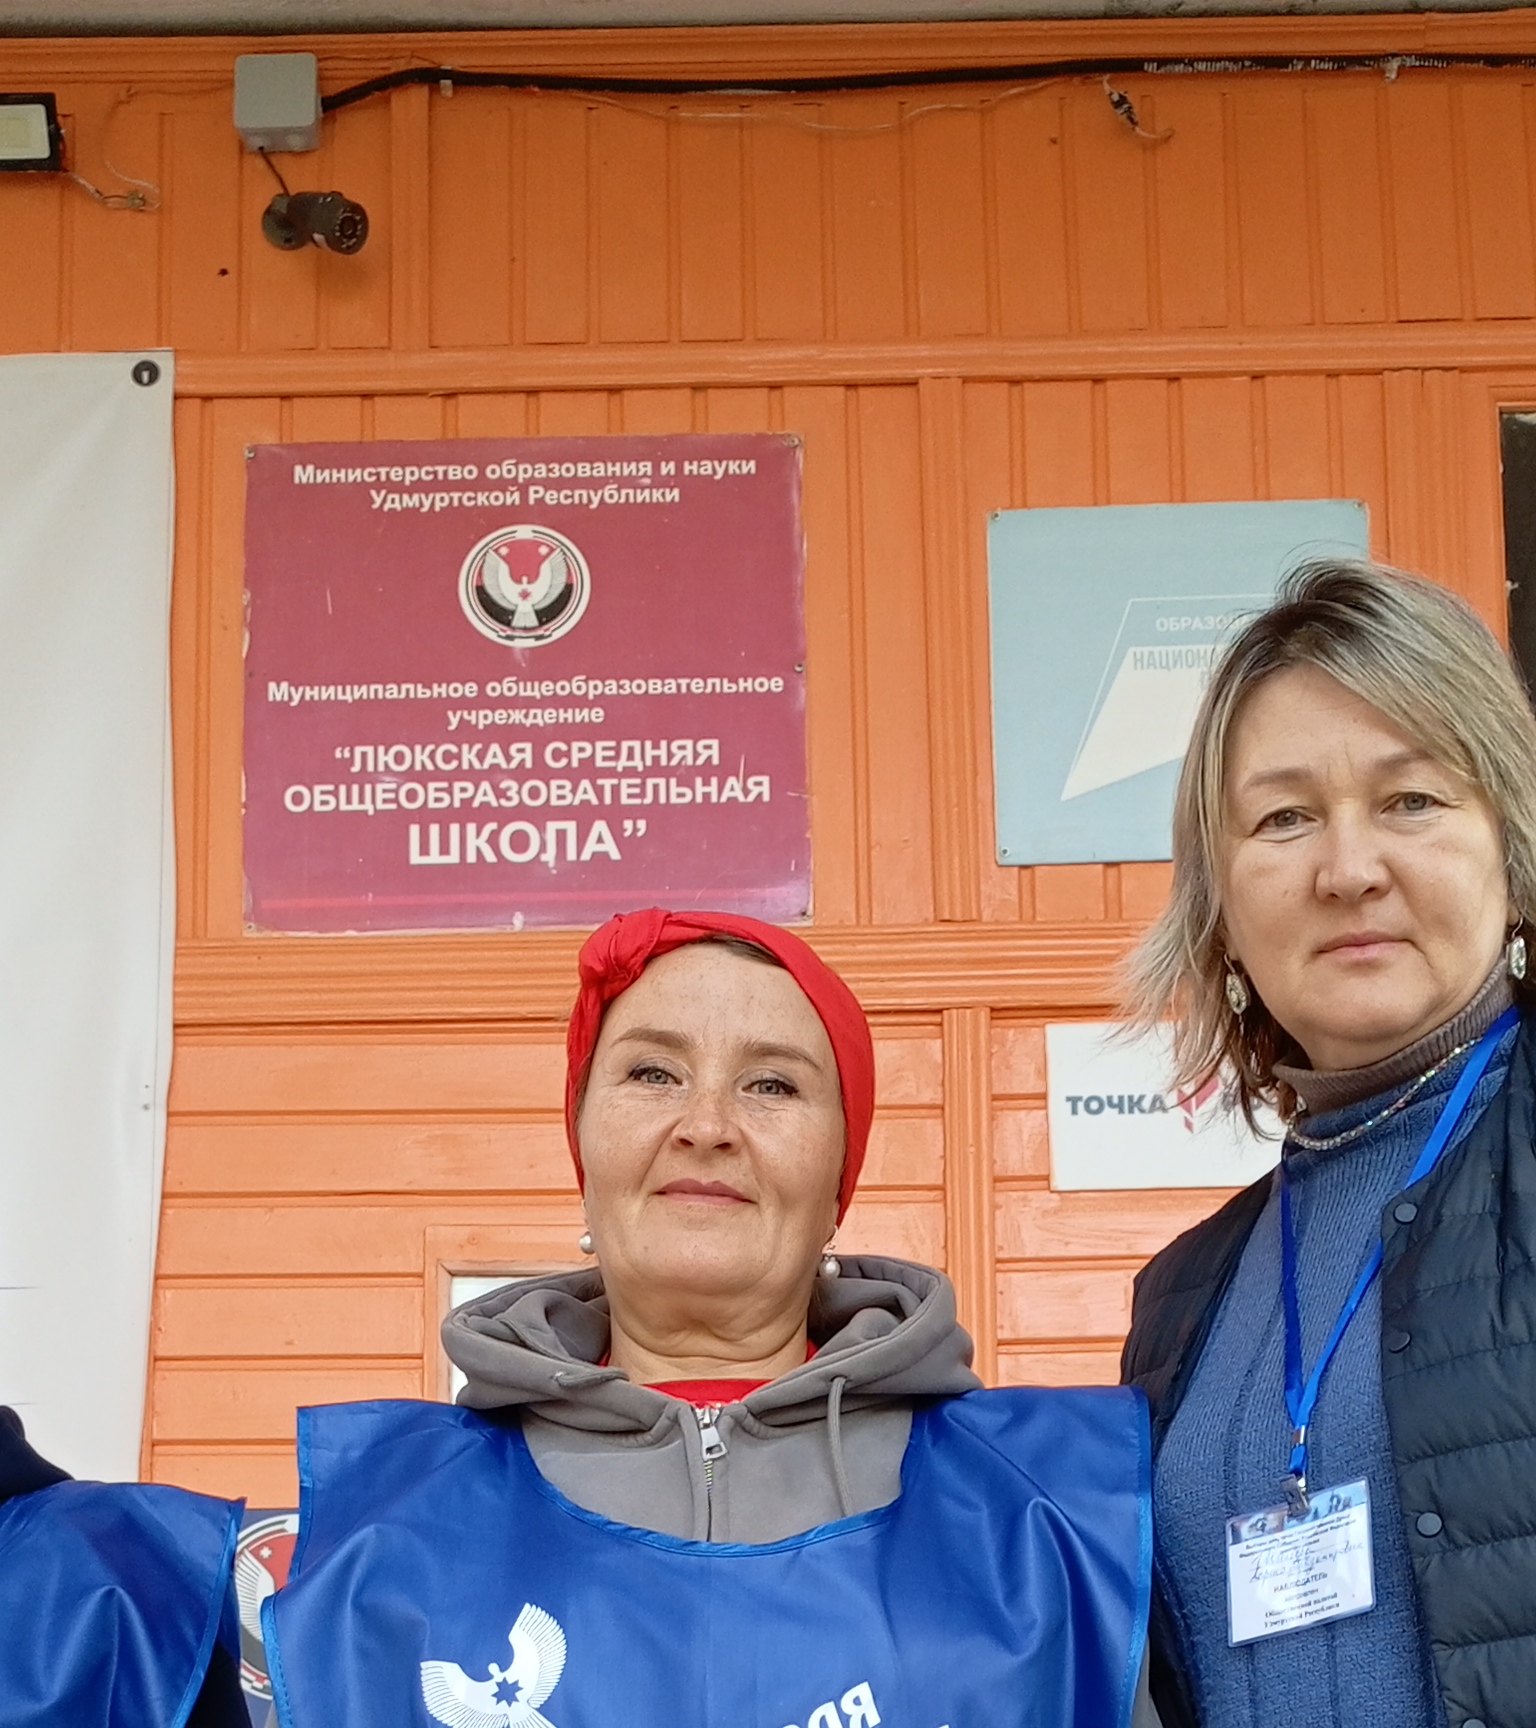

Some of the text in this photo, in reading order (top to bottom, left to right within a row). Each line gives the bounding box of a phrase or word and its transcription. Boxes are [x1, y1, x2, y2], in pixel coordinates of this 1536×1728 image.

[293, 459, 757, 486] Министерство образования и науки
[370, 484, 680, 512] Удмуртской Республики
[267, 675, 784, 707] Муниципальное общеобразовательное
[446, 707, 605, 731] учреждение
[544, 738, 720, 773] СРЕДНЯЯ
[283, 775, 771, 816] ОБЩЕОБРАЗОВАТЕЛЬНАЯ
[1065, 1093, 1169, 1116] ТОЧКА
